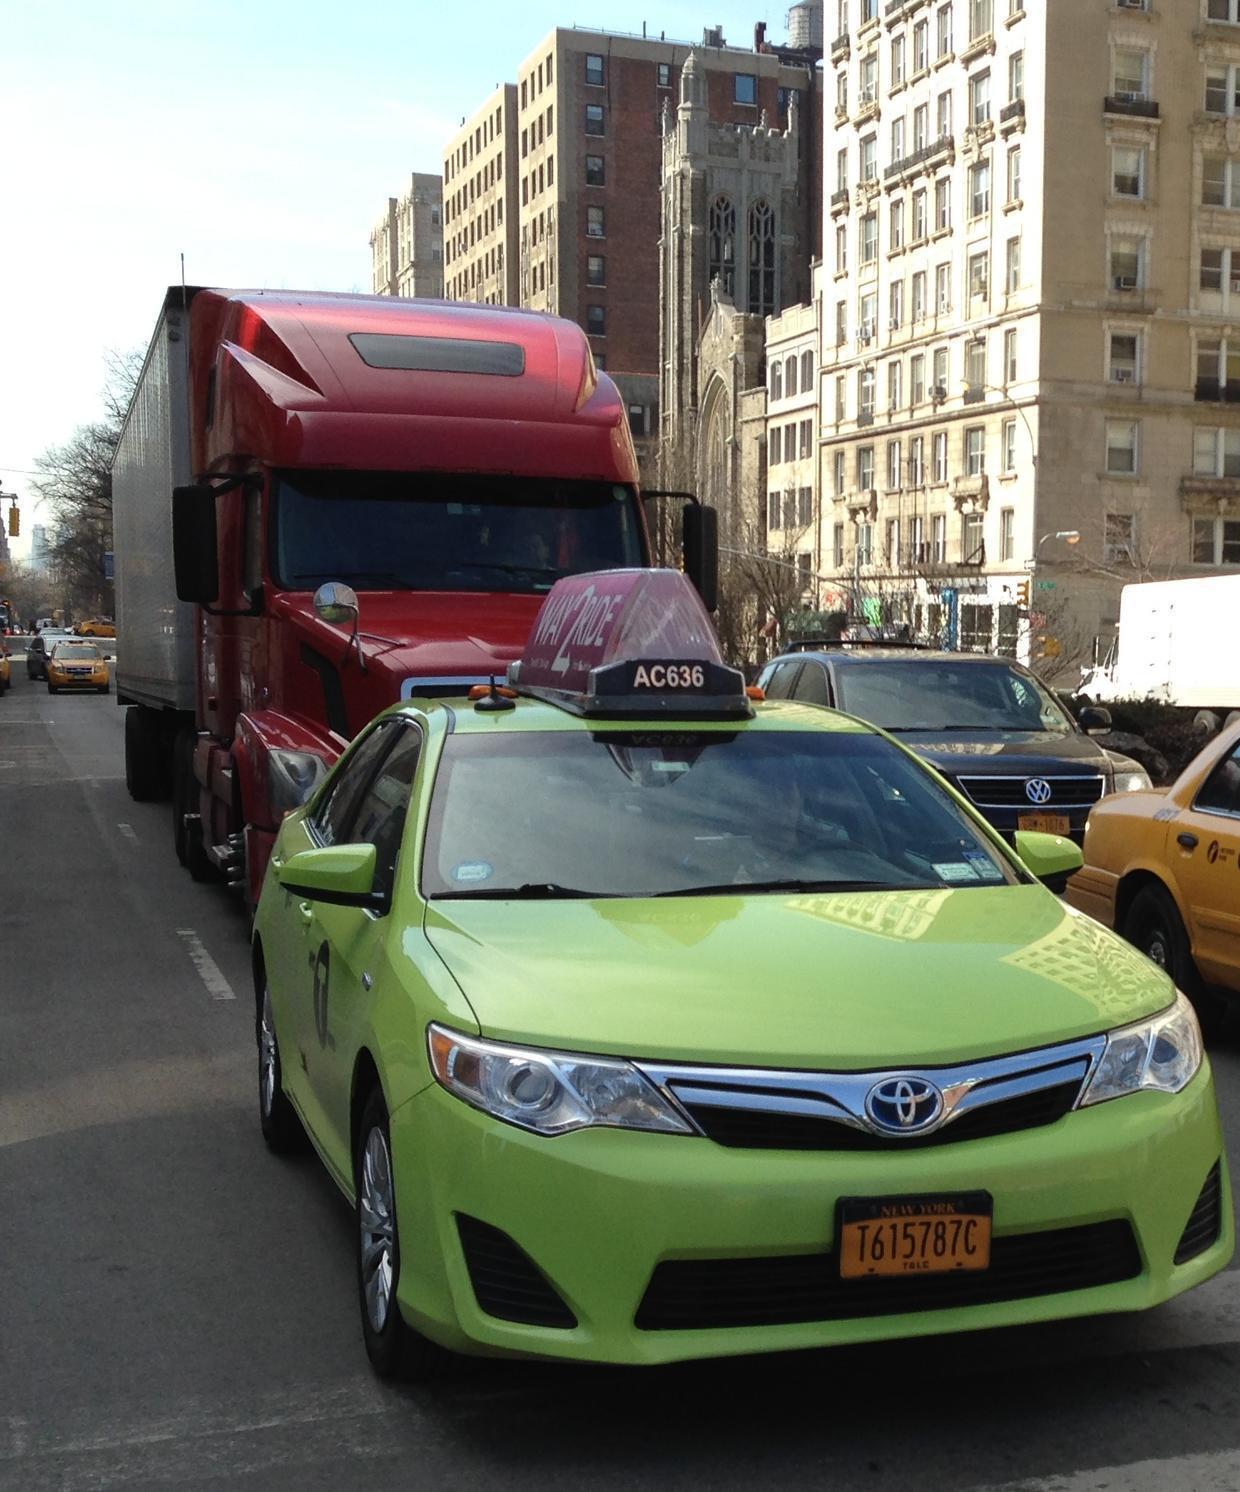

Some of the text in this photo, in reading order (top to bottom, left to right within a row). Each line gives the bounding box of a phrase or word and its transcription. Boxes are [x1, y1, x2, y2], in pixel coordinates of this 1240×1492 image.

[633, 665, 704, 688] AC636
[880, 1202, 956, 1217] NEW YORK
[857, 1219, 978, 1262] T615787C
